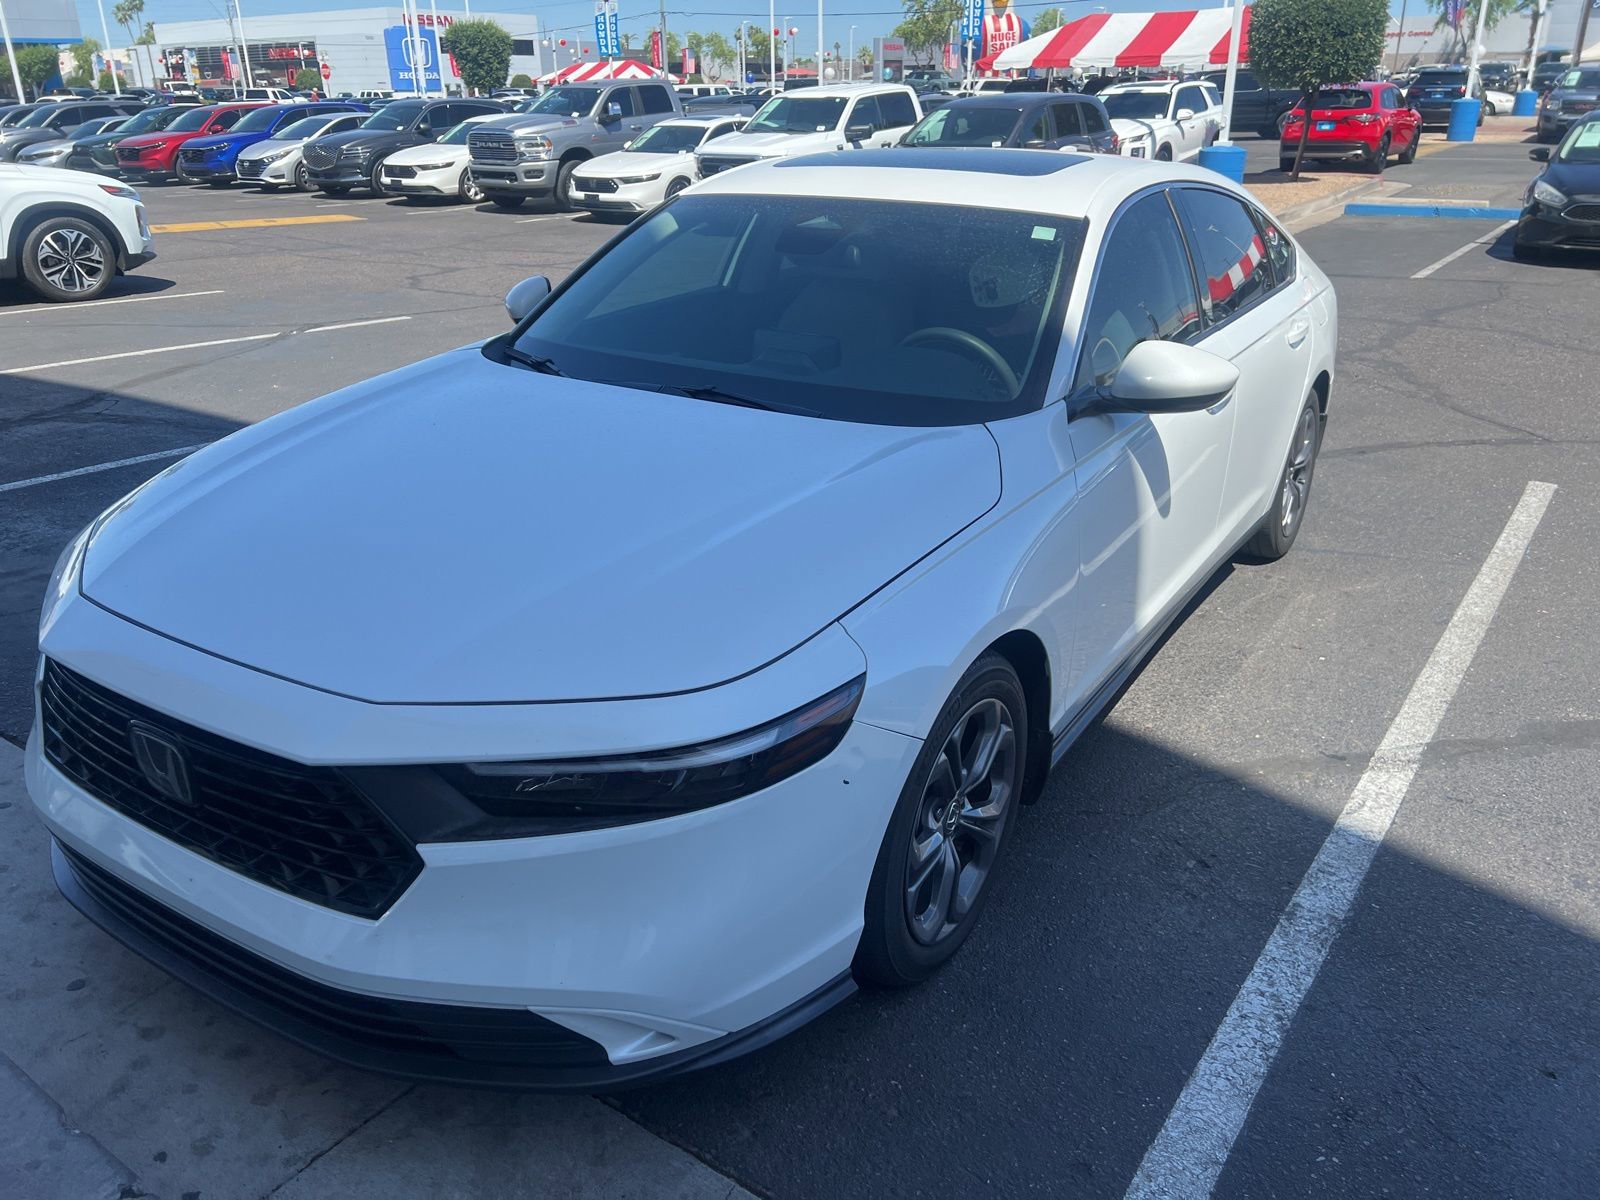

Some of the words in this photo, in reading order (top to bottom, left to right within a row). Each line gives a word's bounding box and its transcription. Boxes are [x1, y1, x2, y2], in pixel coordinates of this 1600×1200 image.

[403, 14, 453, 27] NSSAN
[597, 16, 608, 53] HONDA
[610, 16, 619, 53] HONDA
[991, 32, 1017, 43] HUGE
